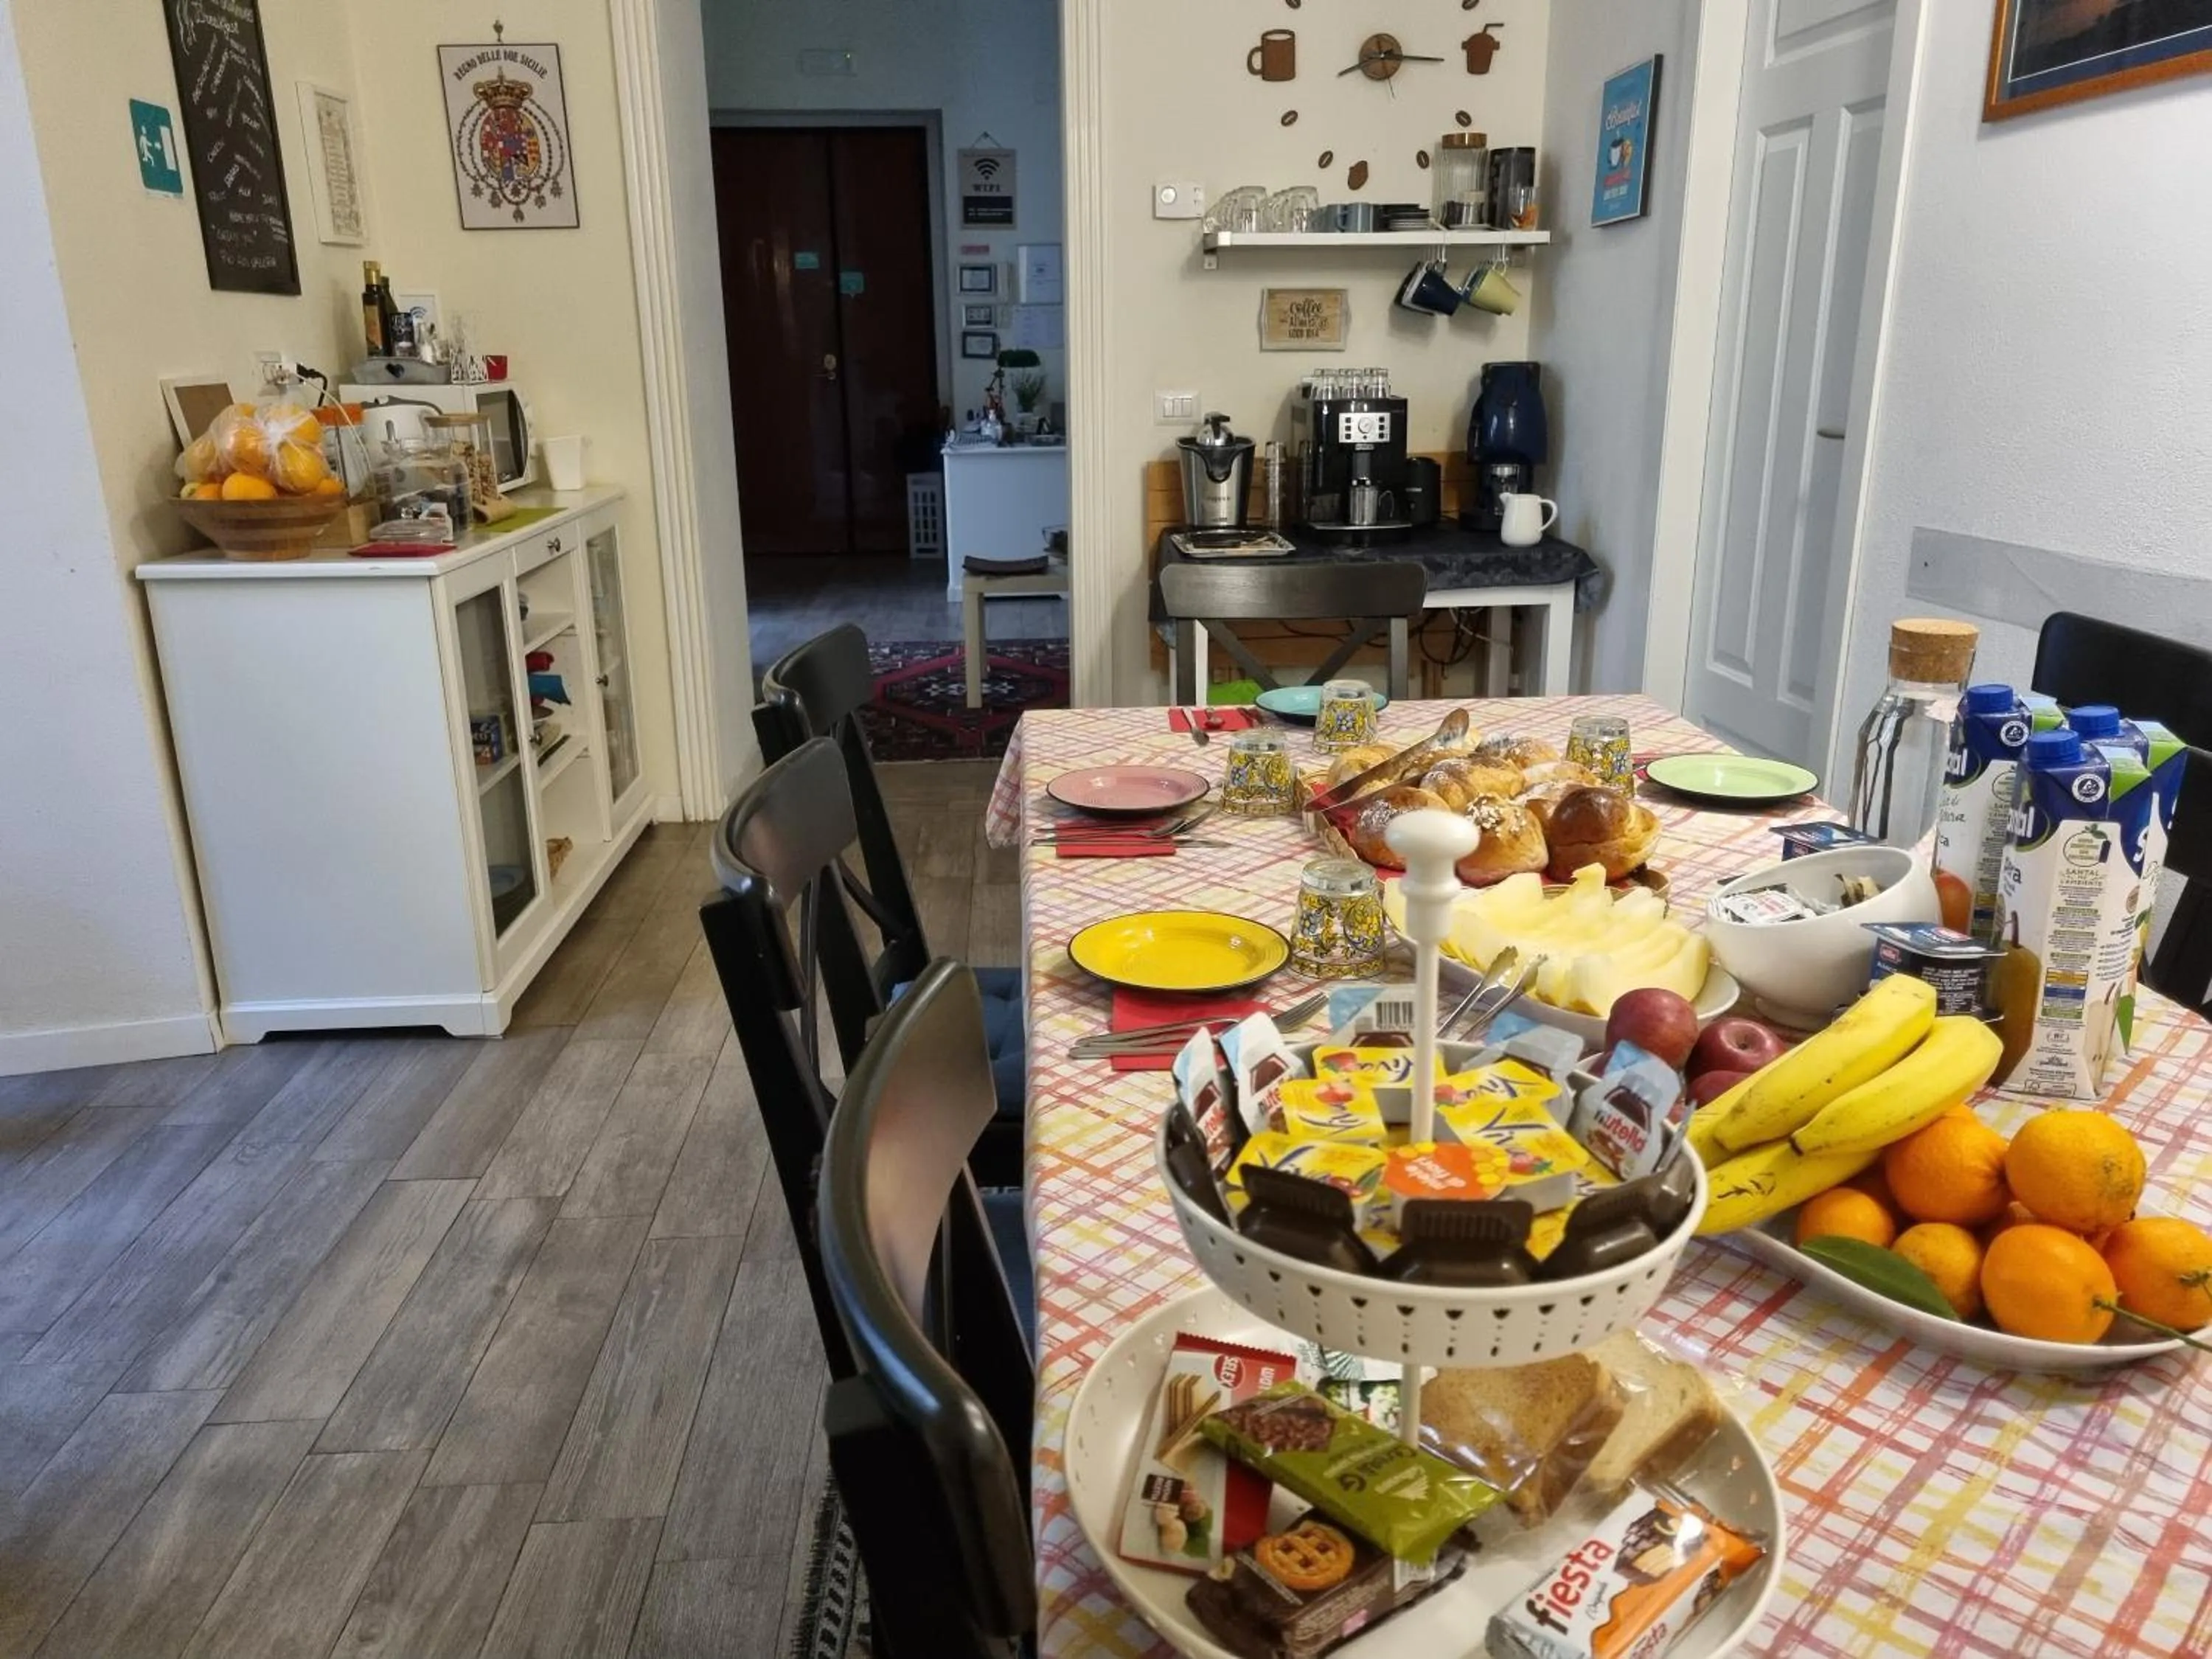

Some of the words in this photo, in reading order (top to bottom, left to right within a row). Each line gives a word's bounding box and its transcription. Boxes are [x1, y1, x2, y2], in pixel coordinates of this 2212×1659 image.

[453, 58, 477, 80] REGNO
[476, 49, 502, 65] DELLE
[503, 49, 519, 63] DUE
[520, 55, 548, 79] SICILIE
[2065, 868, 2099, 877] SANTAL
[1593, 1109, 1648, 1156] nutella
[1218, 1354, 1240, 1388] SELEX
[1526, 1540, 1615, 1635] fiesta
